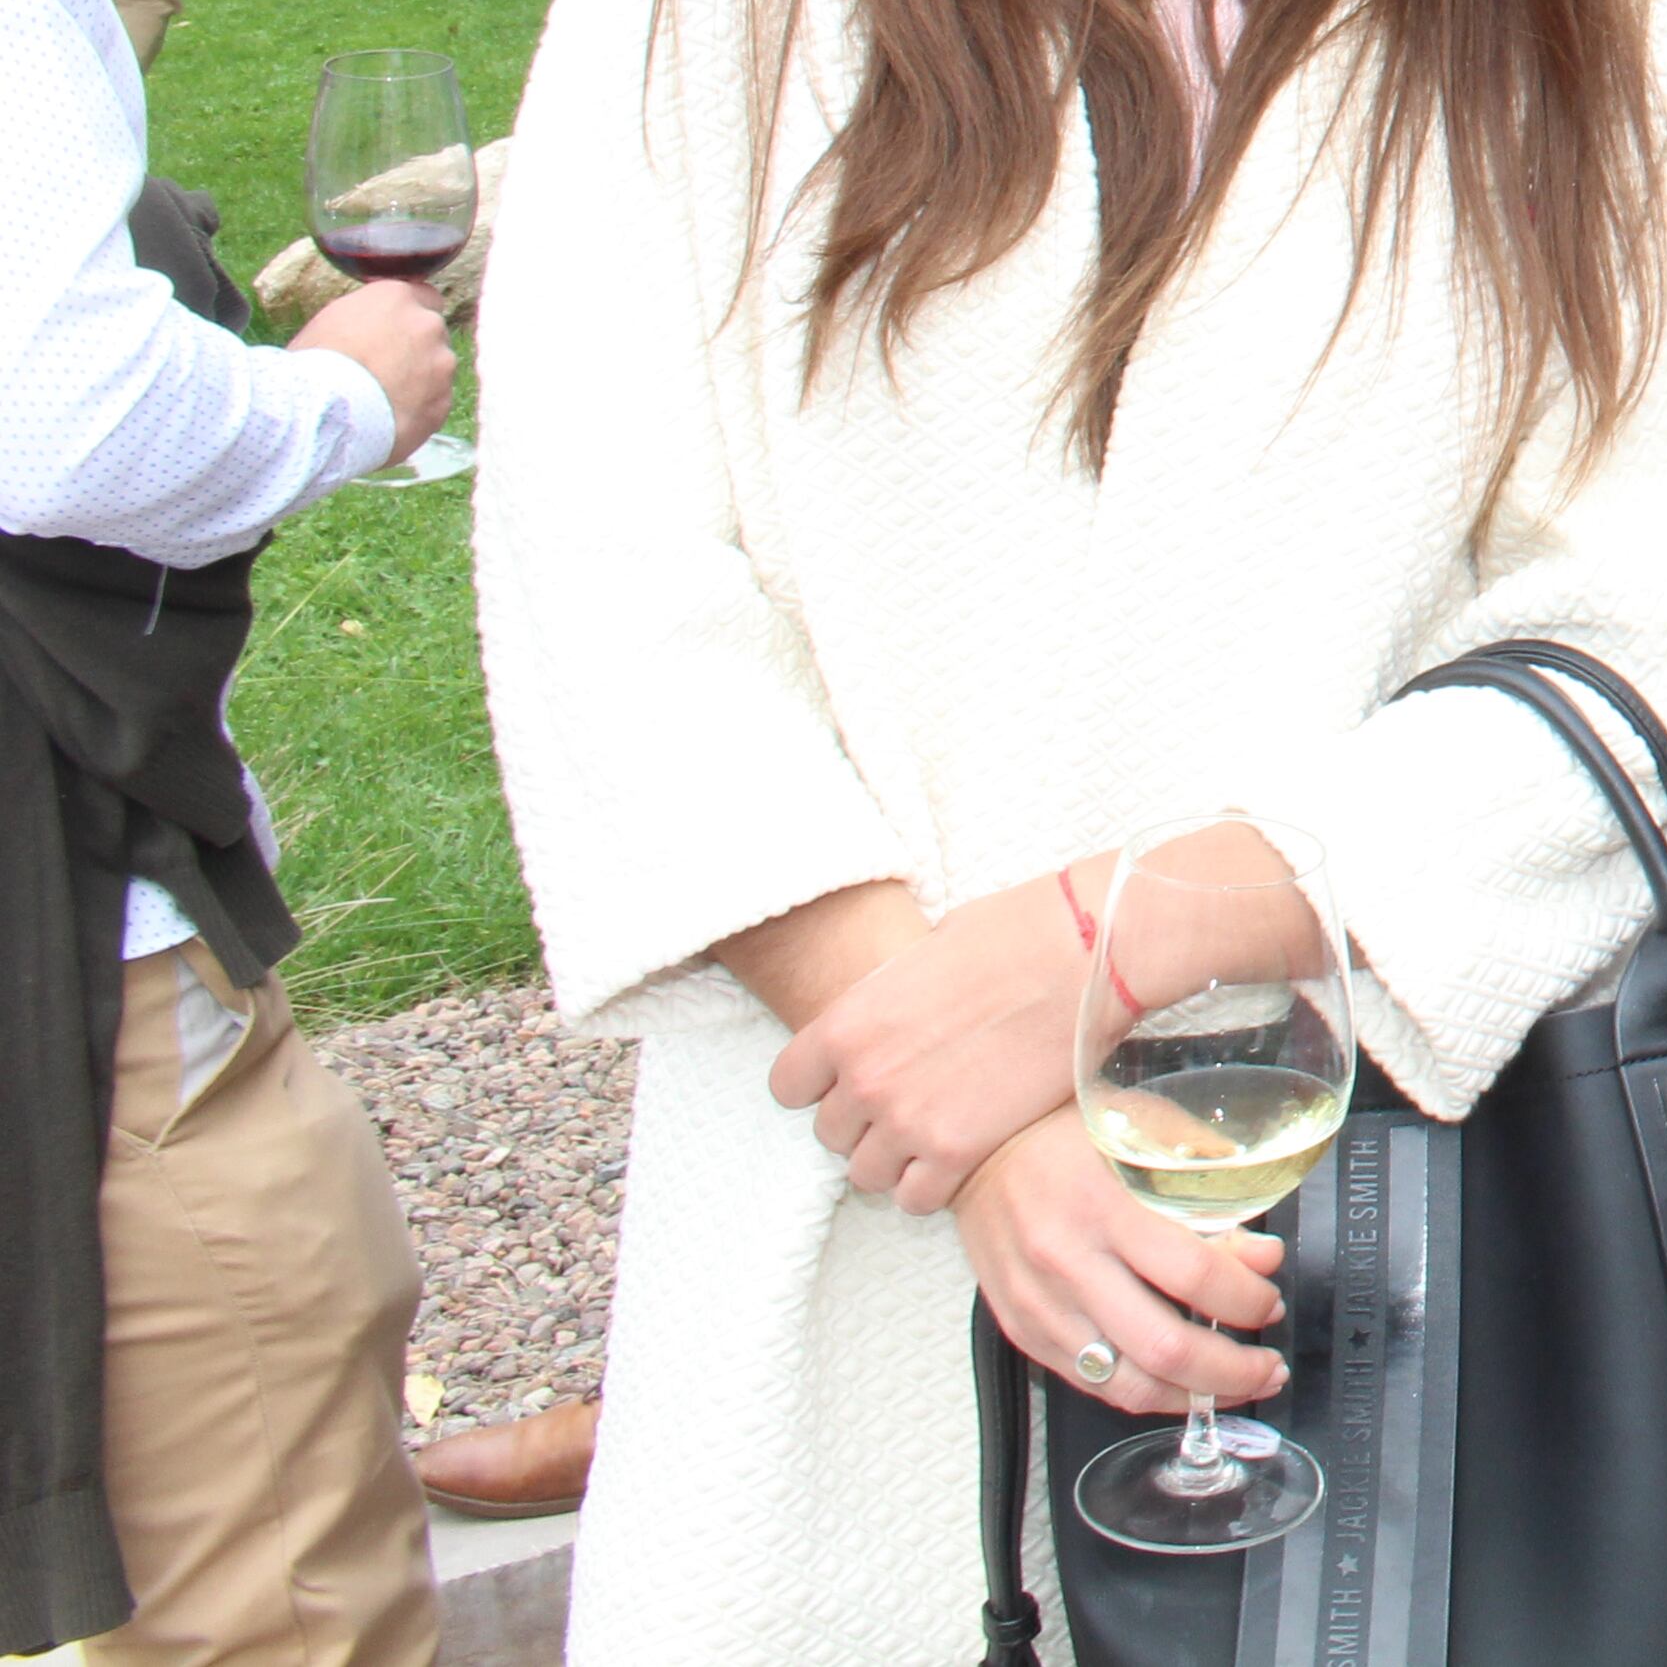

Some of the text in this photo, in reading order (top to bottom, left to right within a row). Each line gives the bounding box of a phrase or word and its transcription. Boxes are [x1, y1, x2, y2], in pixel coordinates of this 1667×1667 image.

[1348, 1140, 1379, 1220] SMITH
[1346, 1229, 1378, 1321] JACKIE
[1343, 1360, 1375, 1442] SMITH
[1336, 1451, 1371, 1543] JACKIE
